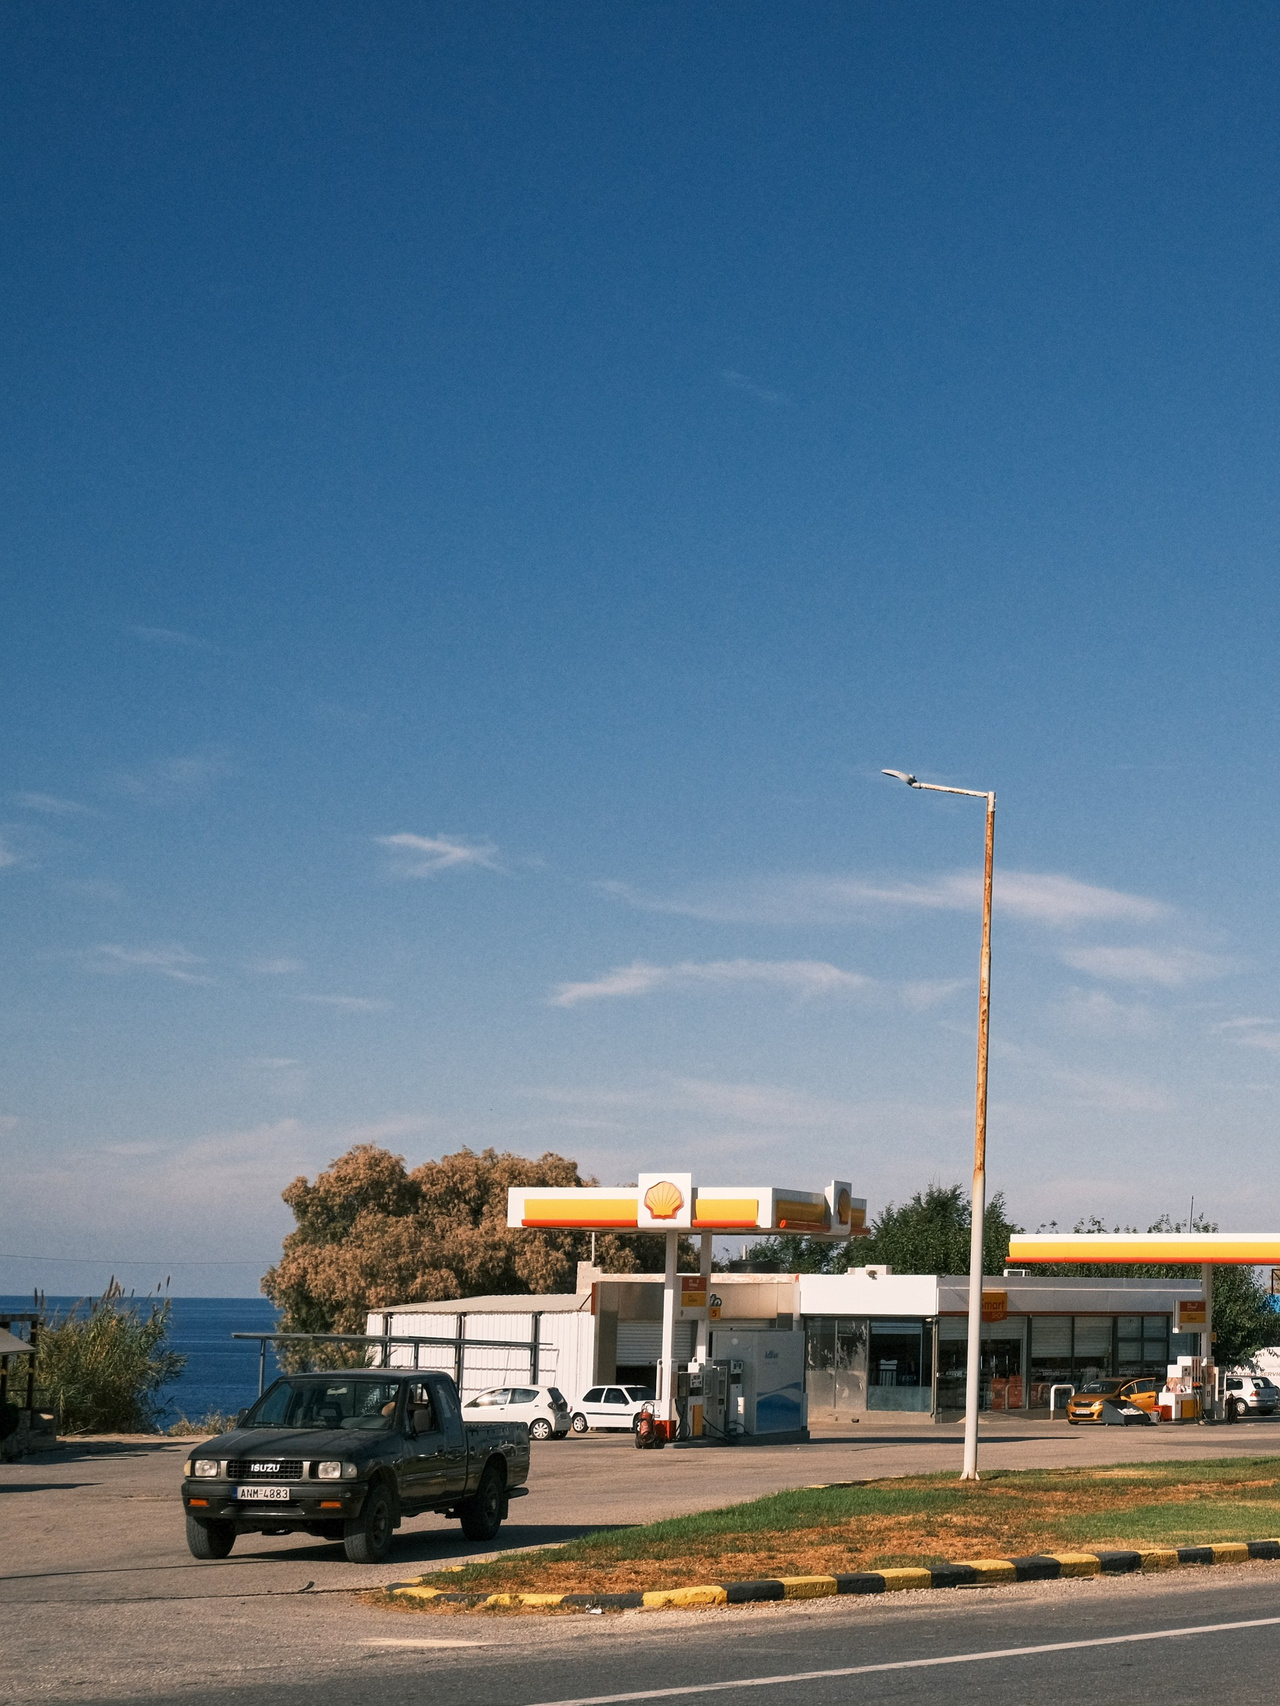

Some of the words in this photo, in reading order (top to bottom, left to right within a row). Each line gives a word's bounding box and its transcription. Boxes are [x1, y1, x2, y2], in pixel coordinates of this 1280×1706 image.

[712, 1309, 717, 1317] 5
[250, 1463, 280, 1472] ISUZU
[240, 1488, 288, 1499] ANM-4883
